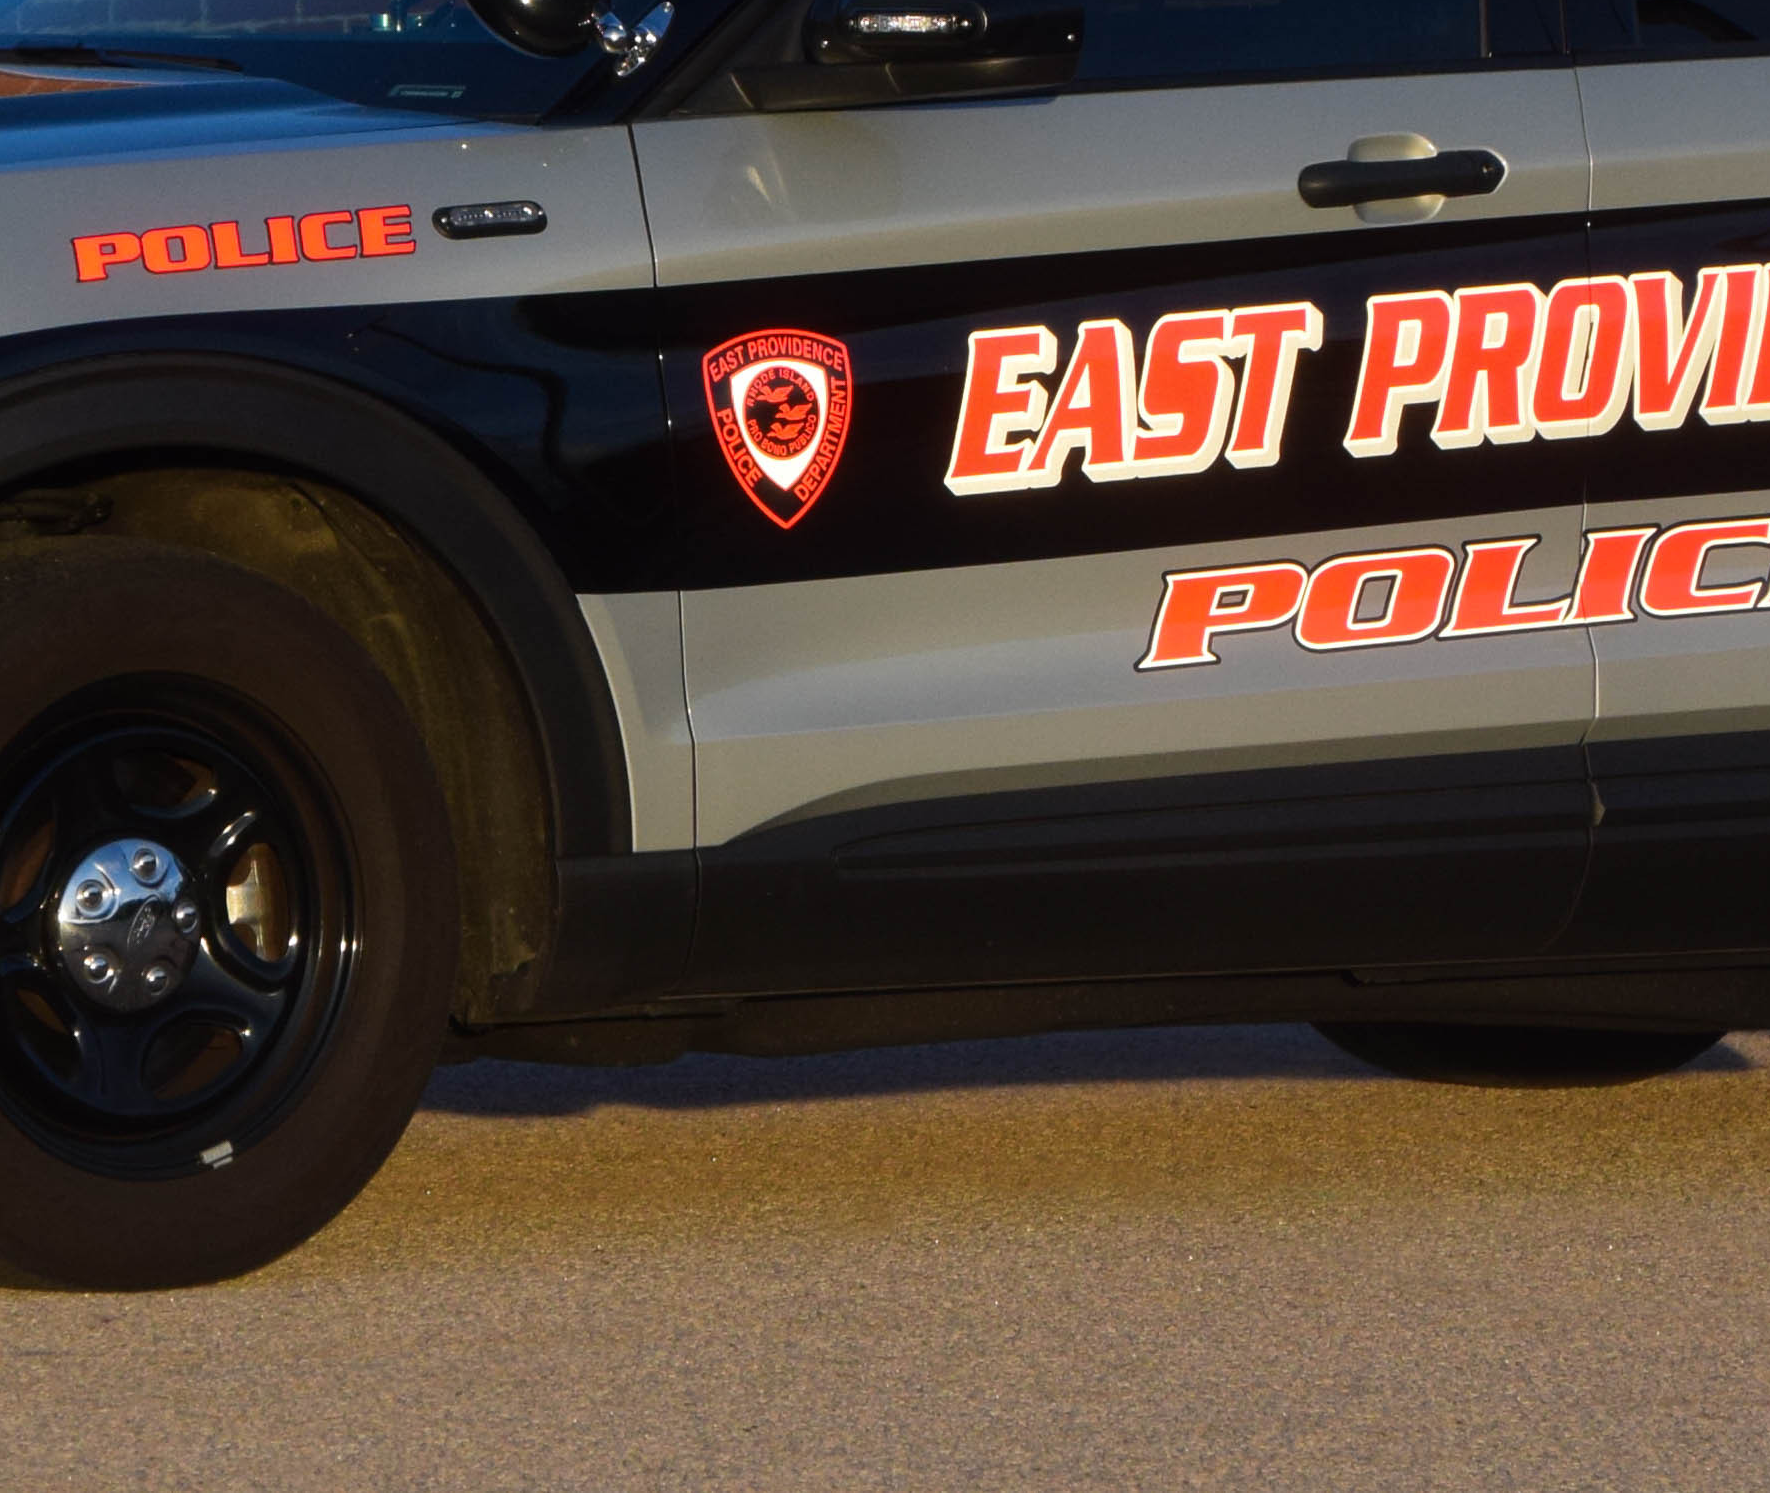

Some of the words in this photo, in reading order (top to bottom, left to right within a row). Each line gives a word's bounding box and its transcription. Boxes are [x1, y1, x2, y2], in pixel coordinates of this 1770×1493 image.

[71, 204, 417, 283] POLICE
[709, 345, 744, 383] EAST
[747, 336, 843, 371] PROVIDENCE
[745, 368, 776, 407] RHODE
[779, 368, 815, 401] ISLAND
[943, 300, 1323, 497] EAST
[717, 408, 764, 488] POLICE
[793, 375, 848, 503] DEPARTMENT
[748, 418, 763, 441] PRO
[788, 414, 817, 454] PUBLICO
